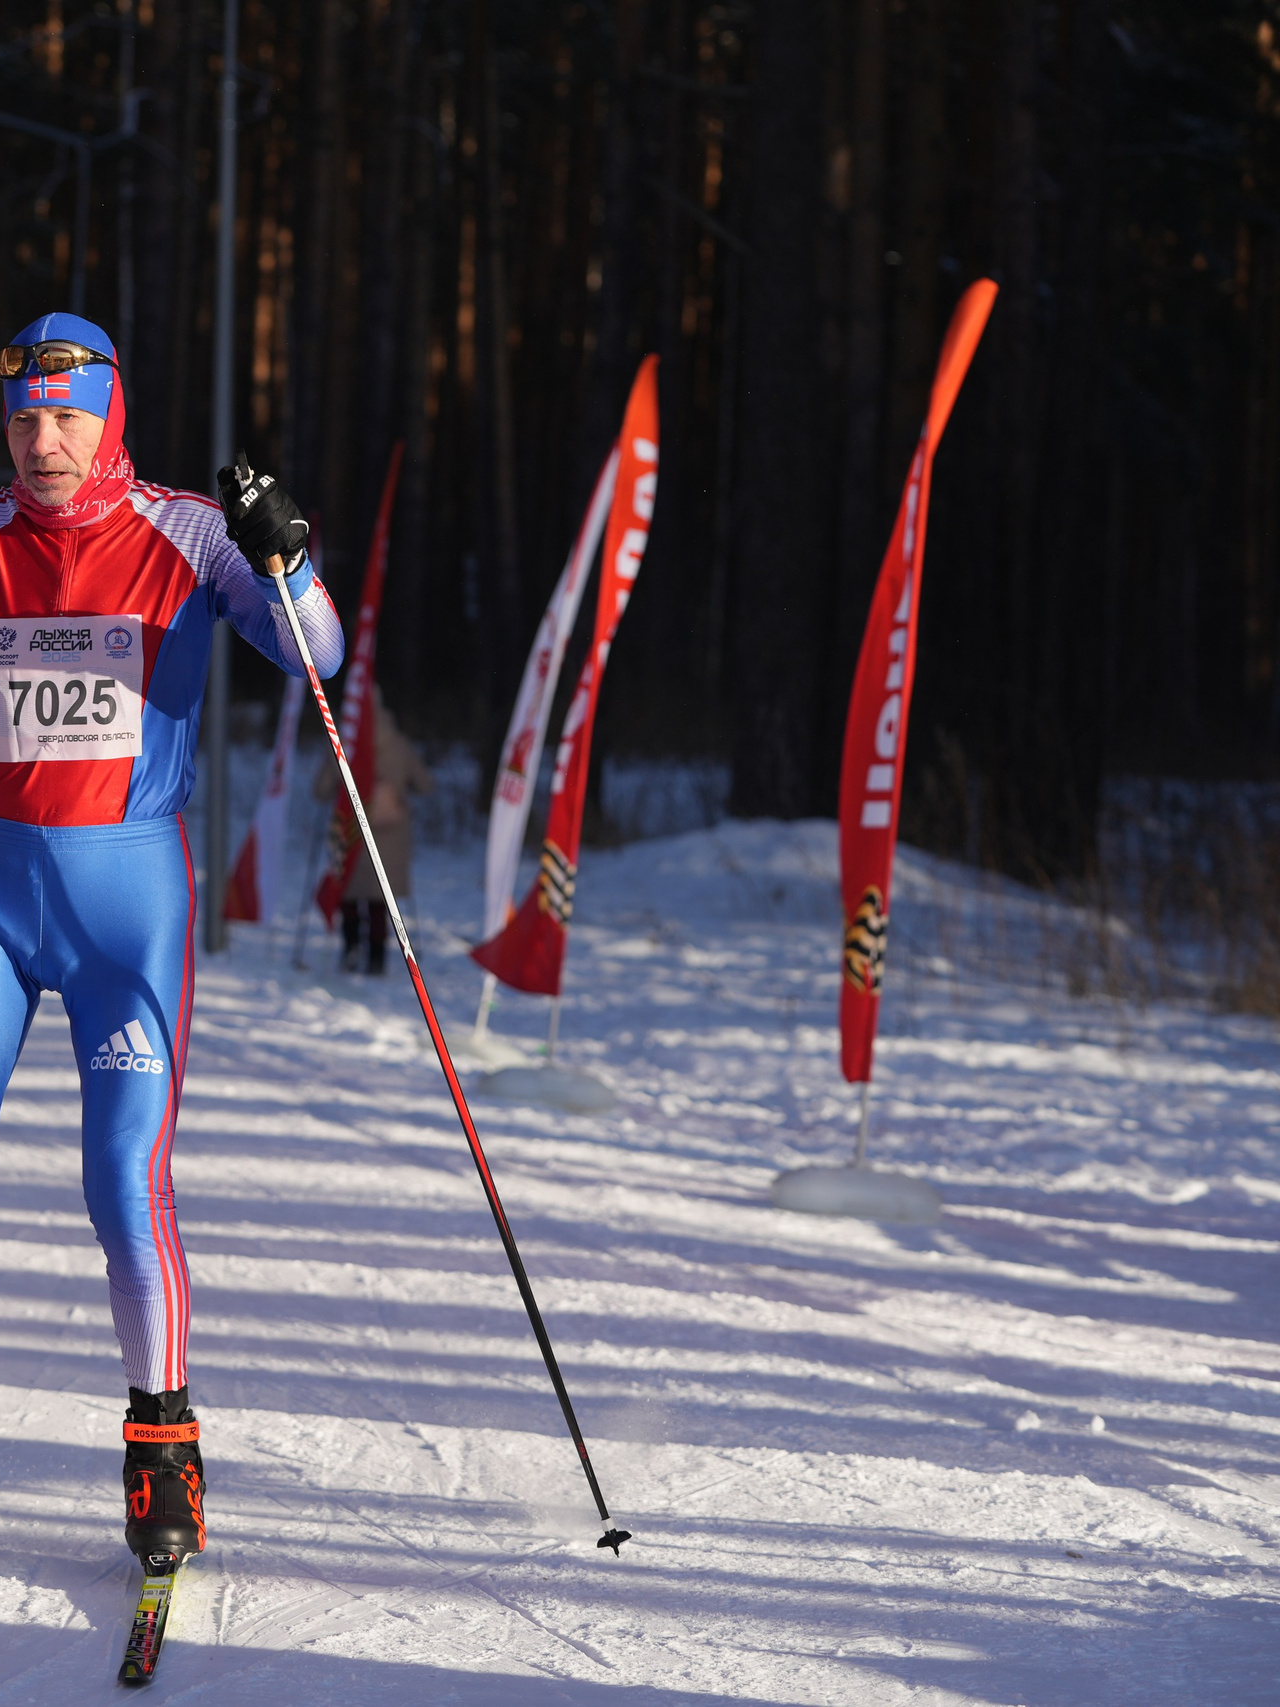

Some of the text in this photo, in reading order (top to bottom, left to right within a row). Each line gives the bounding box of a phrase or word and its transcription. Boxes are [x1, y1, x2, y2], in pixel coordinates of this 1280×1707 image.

[32, 629, 91, 640] ЛЫЖНЯ
[29, 640, 93, 651] РОССИИ
[40, 652, 81, 663] 2025
[8, 679, 117, 727] 7025
[37, 732, 136, 743] СВЕРДЛОВСКАЯ ОБЛАСТЬ
[90, 1051, 164, 1075] adidas
[134, 1429, 182, 1439] ROSSIGNOL
